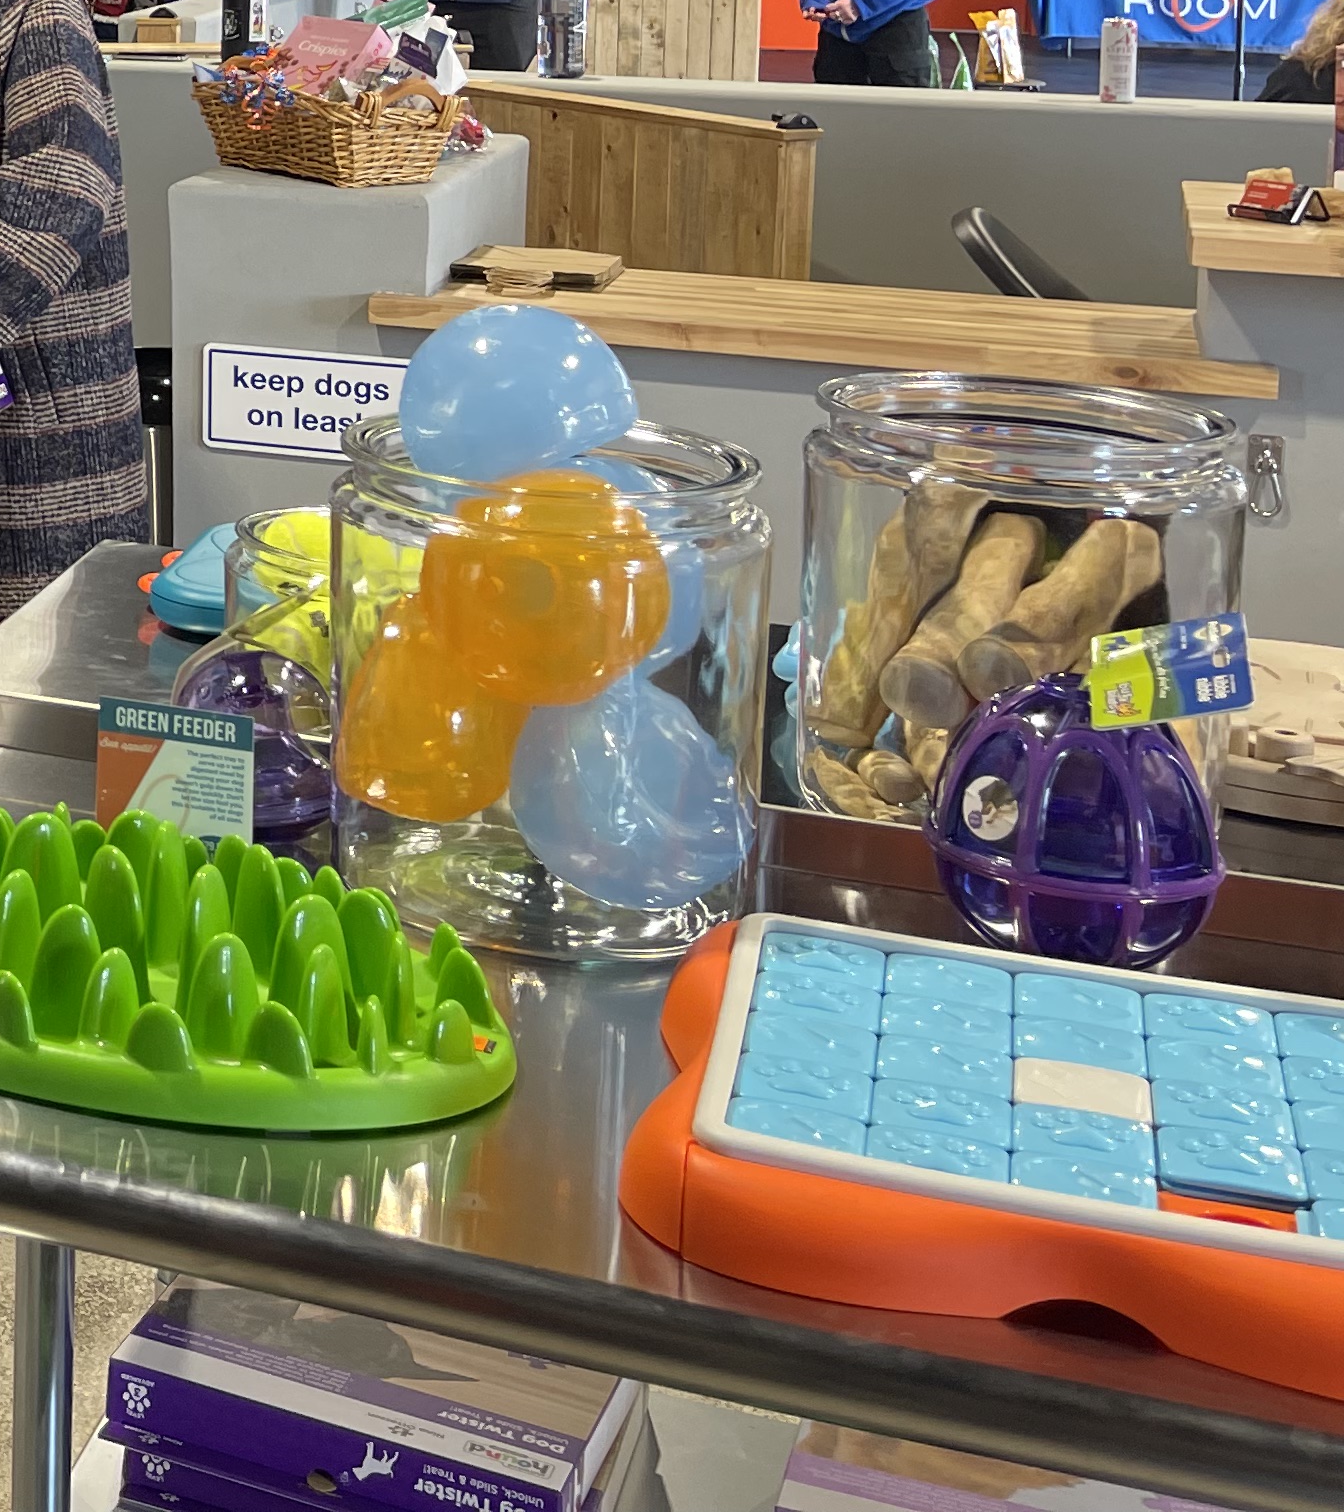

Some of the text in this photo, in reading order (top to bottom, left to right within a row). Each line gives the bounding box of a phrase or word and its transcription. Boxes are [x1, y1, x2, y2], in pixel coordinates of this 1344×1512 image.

[298, 40, 348, 57] Crispies
[232, 365, 390, 405] keep dogs
[247, 407, 362, 433] on leas
[115, 706, 236, 743] GREEN FEEDER
[120, 1373, 156, 1388] ADVANCED
[126, 1408, 145, 1419] LEVEL
[437, 1410, 567, 1455] Dog Twister
[468, 1442, 550, 1475] hound
[422, 1464, 456, 1483] Treat!
[414, 1477, 490, 1512] Twister
[469, 1478, 499, 1495] Slide
[501, 1486, 545, 1510] Unlock,
